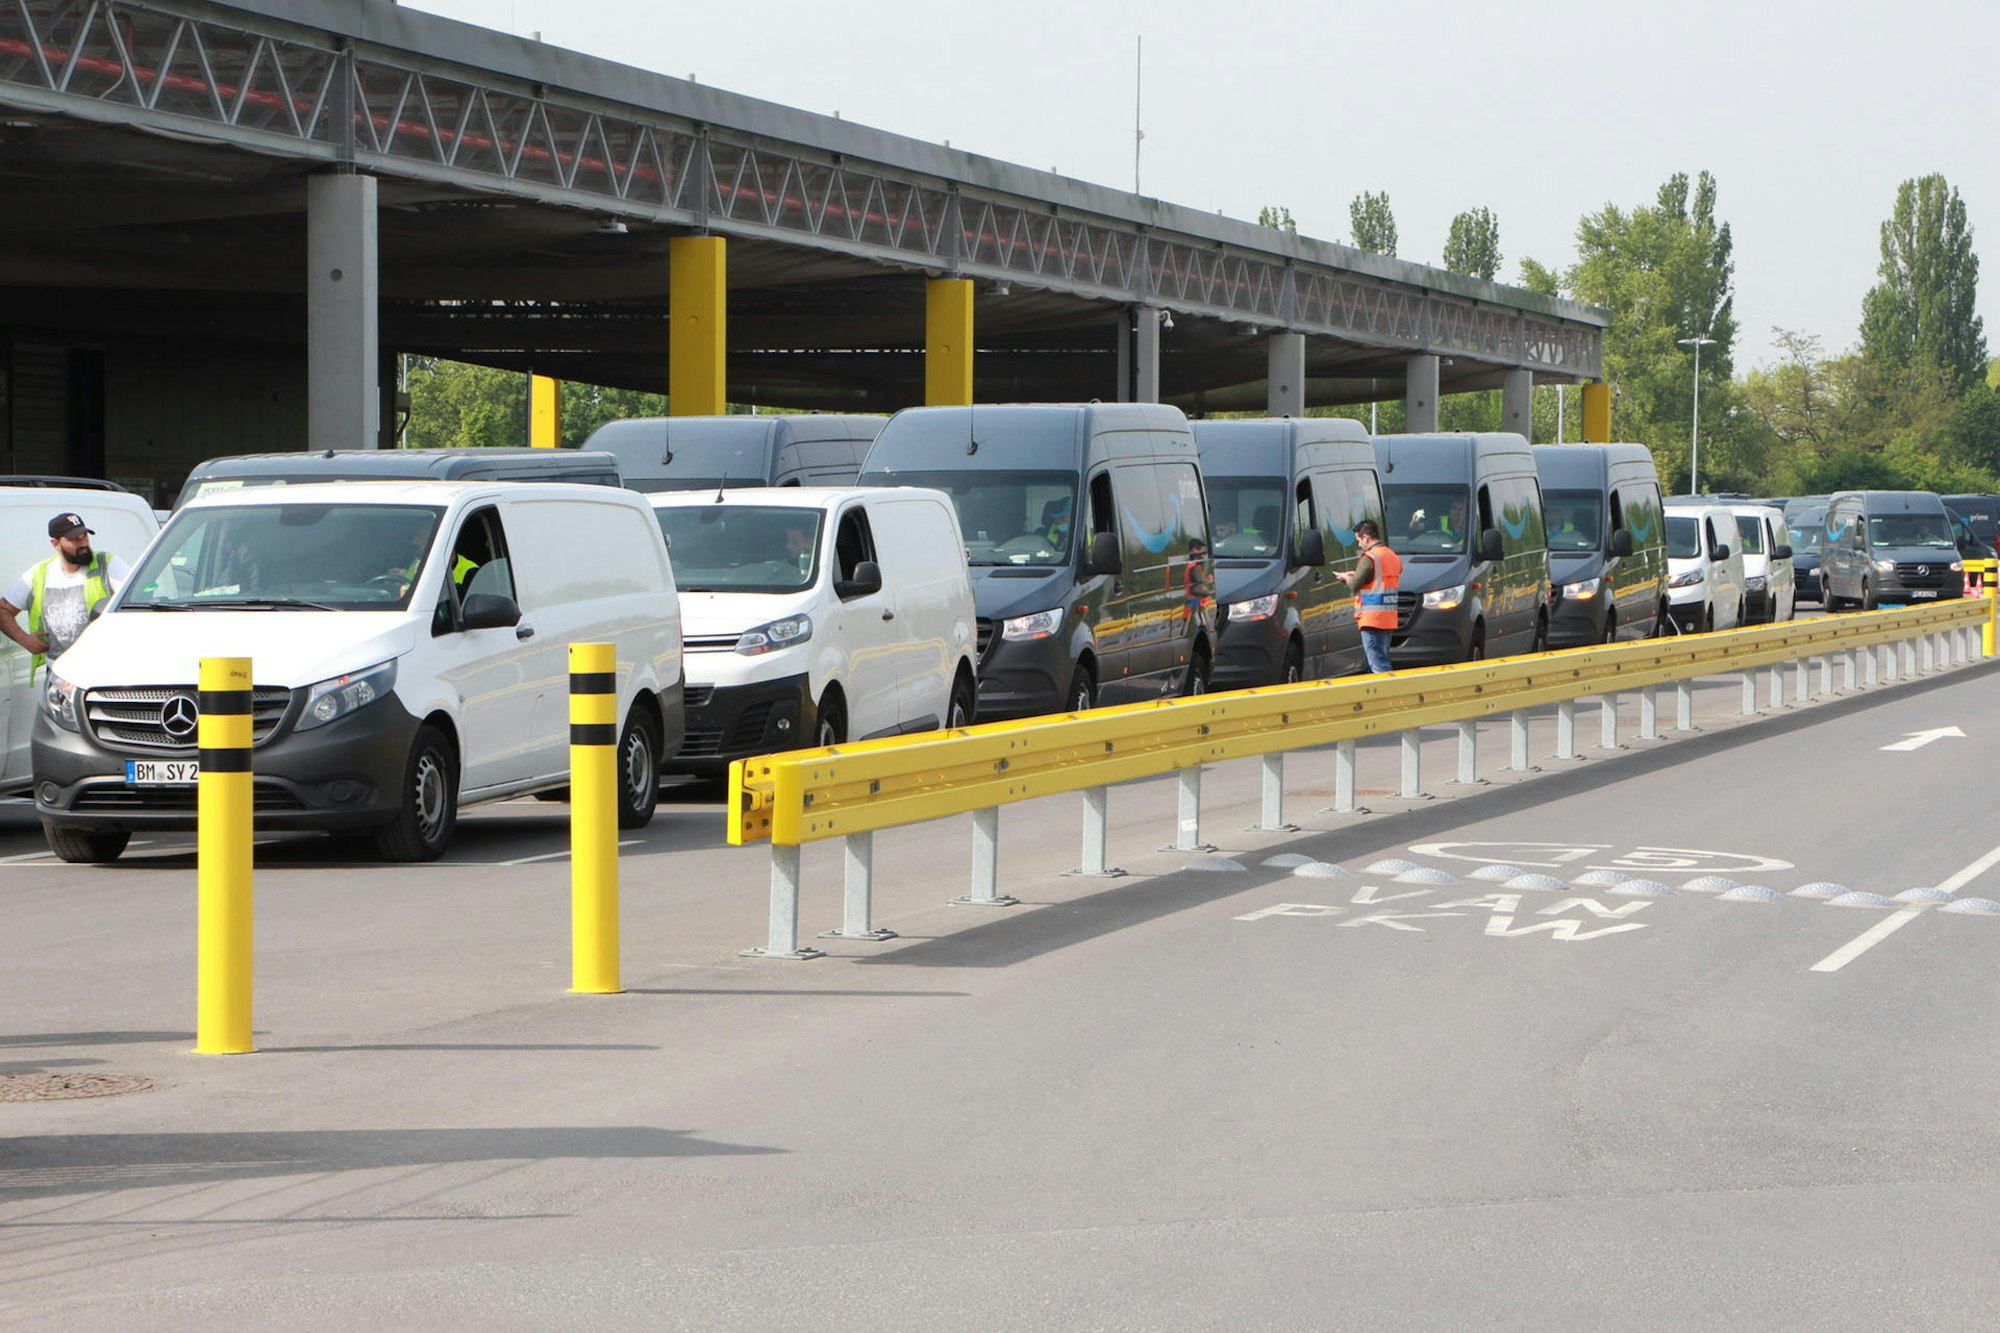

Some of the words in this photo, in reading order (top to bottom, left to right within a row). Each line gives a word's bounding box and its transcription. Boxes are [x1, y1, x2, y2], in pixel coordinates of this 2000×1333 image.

[1969, 512, 1989, 523] prime
[137, 763, 155, 780] BM
[166, 763, 185, 780] SY
[1351, 886, 1653, 919] VAN
[1232, 903, 1649, 941] PKW
